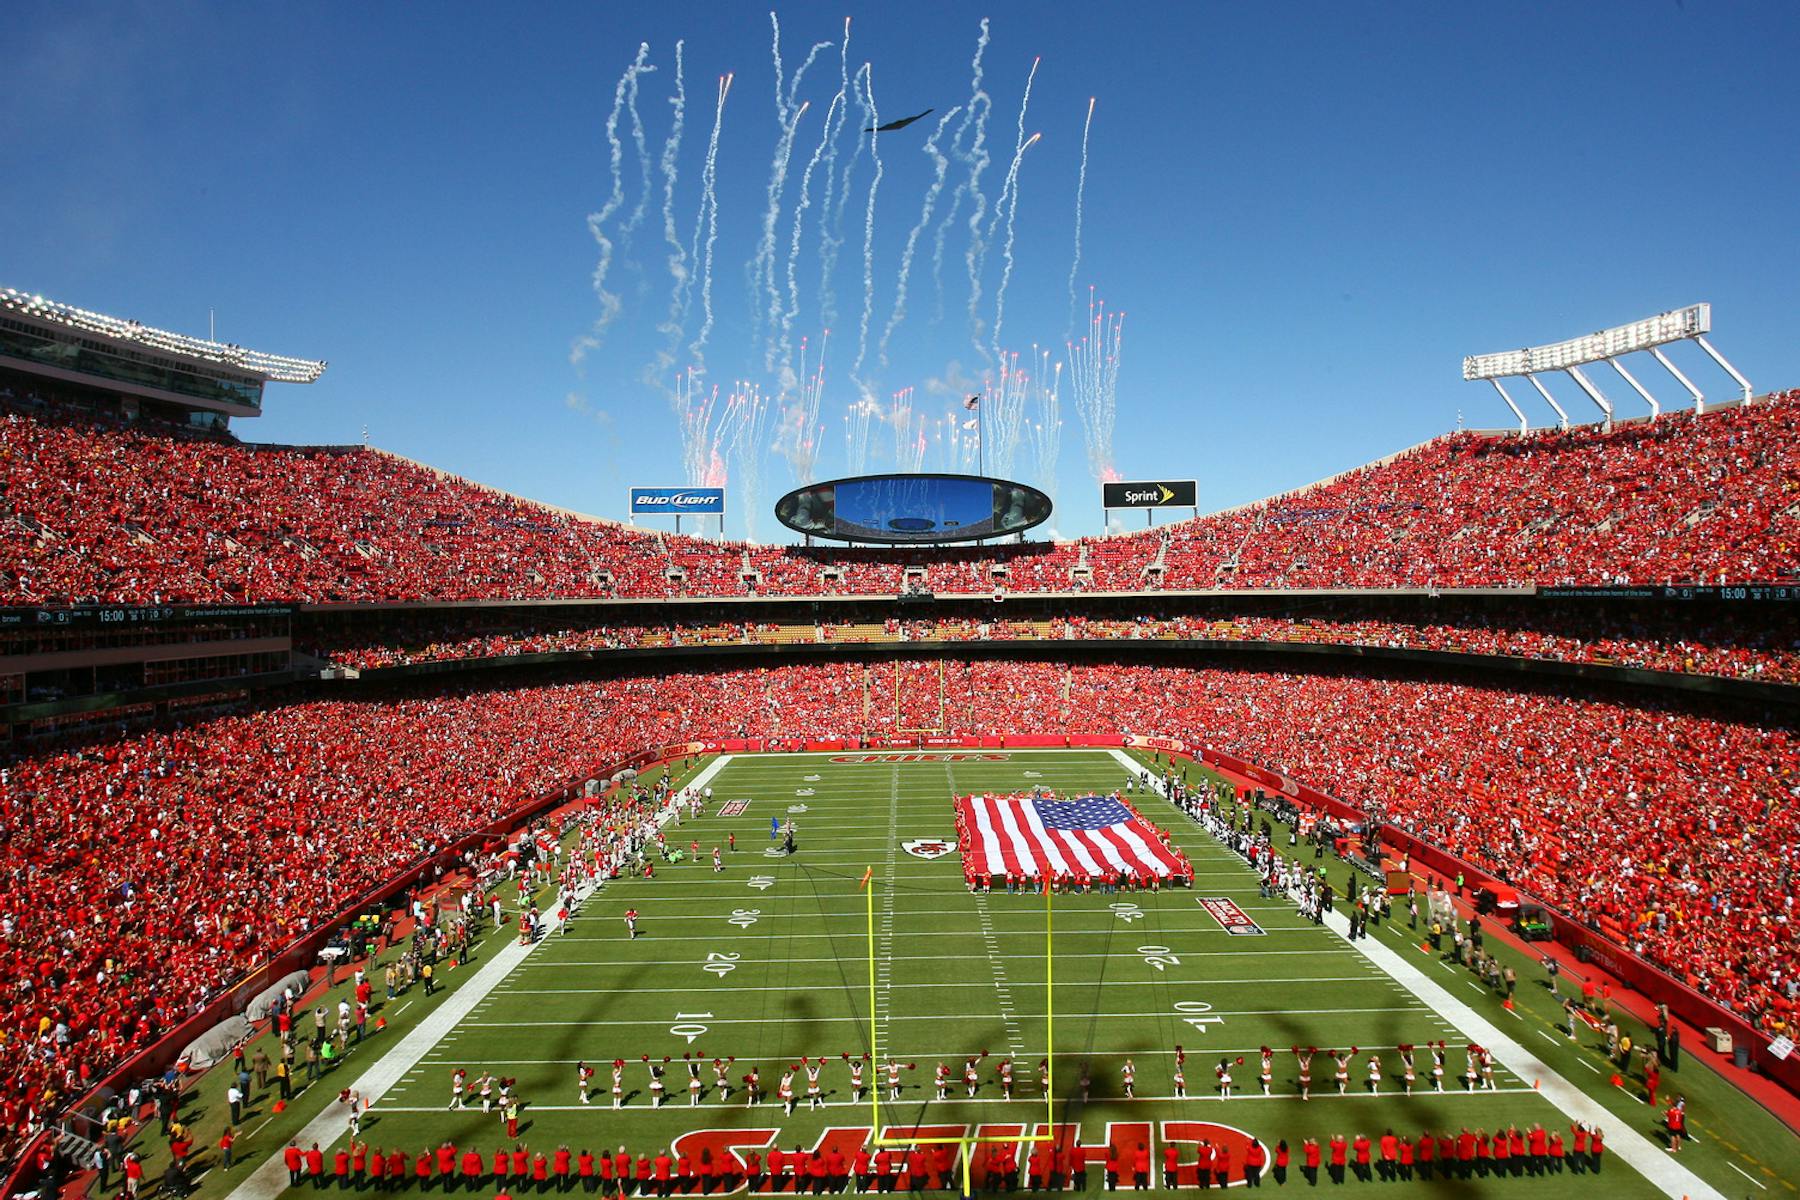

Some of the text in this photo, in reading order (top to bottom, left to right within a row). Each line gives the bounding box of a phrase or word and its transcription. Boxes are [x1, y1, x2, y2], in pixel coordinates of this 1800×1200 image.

[636, 496, 719, 505] BUD LIGHT
[1125, 490, 1158, 505] Sprint
[1721, 588, 1746, 599] 15:00
[99, 610, 124, 622] 15:00
[1147, 738, 1173, 749] CHIEFS
[828, 753, 1011, 764] CHIEFS
[1137, 945, 1181, 966] 20
[703, 952, 741, 973] 20
[1174, 1001, 1225, 1025] 10
[670, 1012, 714, 1036] 10
